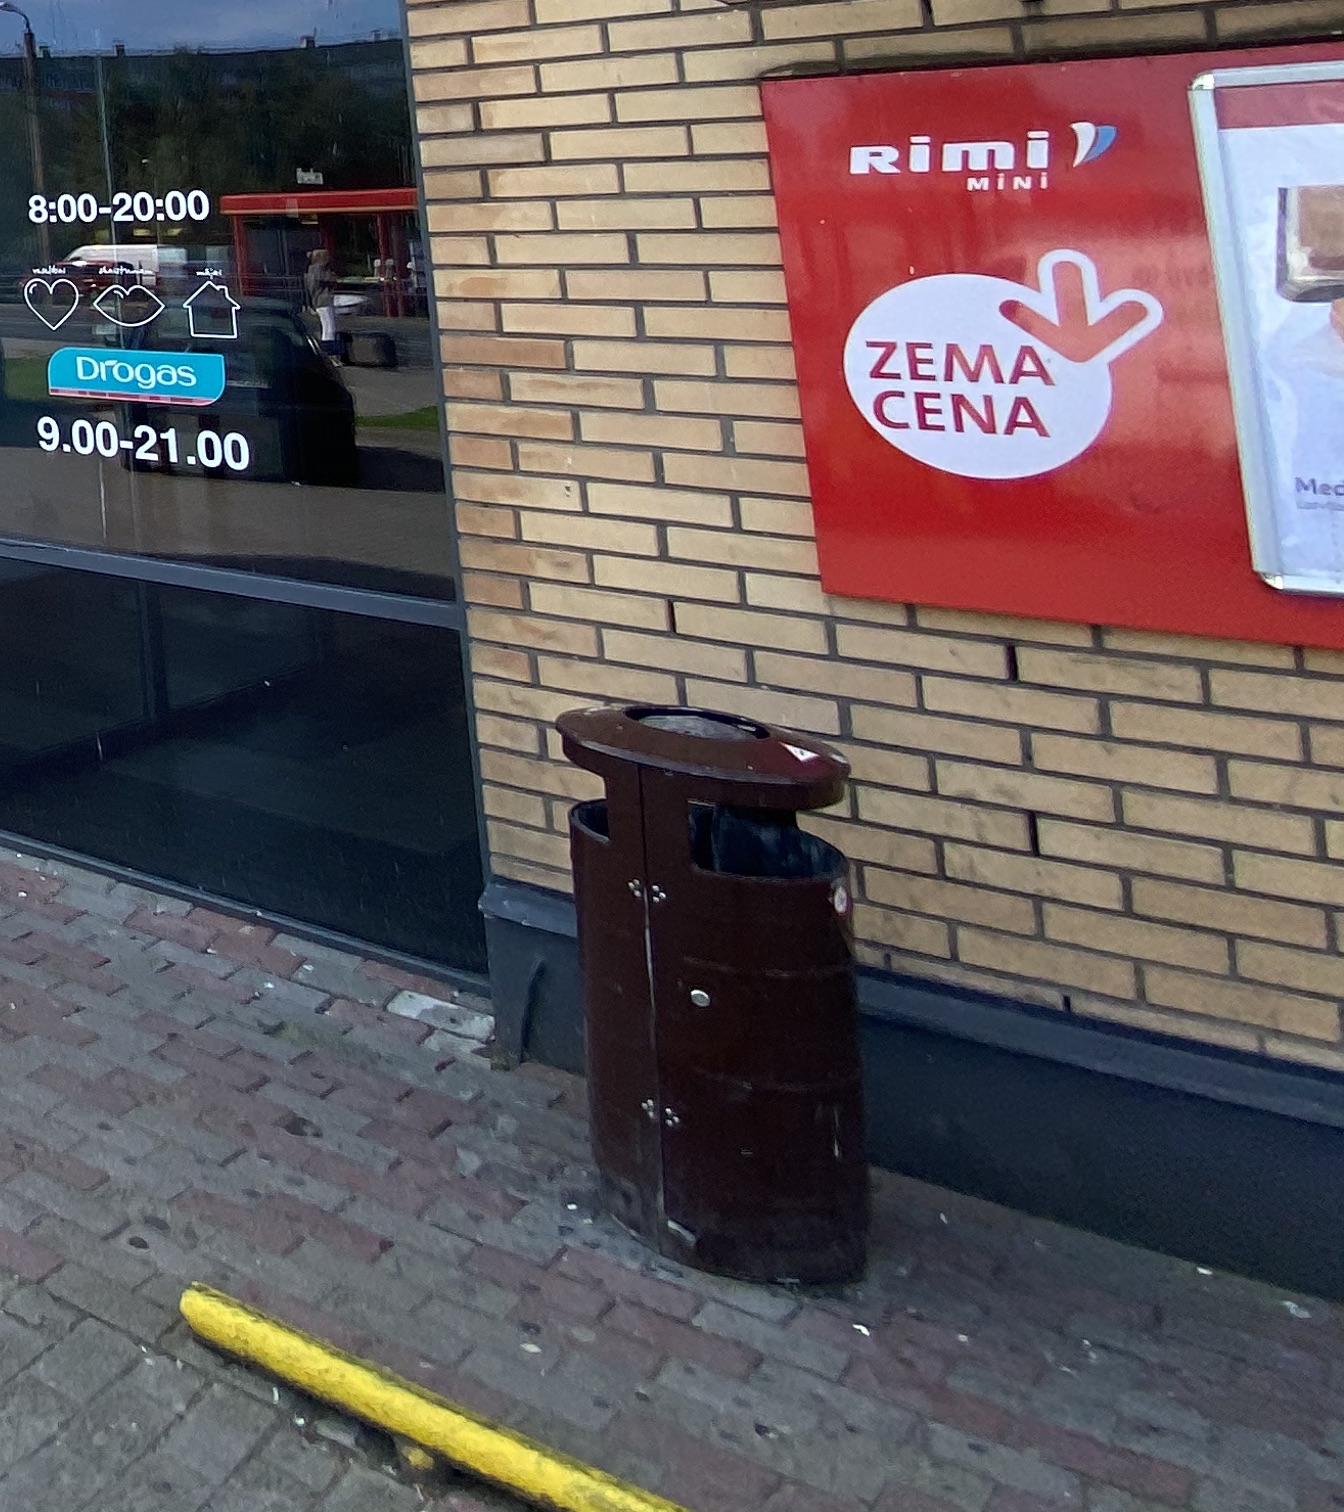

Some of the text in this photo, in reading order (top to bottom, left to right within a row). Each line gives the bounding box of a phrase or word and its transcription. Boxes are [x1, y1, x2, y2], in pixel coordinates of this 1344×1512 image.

[849, 130, 1049, 175] Rimi
[27, 189, 210, 224] 8:00-20:00
[75, 354, 198, 390] Drogas
[865, 340, 1056, 386] ZEMA
[872, 390, 1051, 437] CENA
[36, 416, 250, 471] 9.00-21.00
